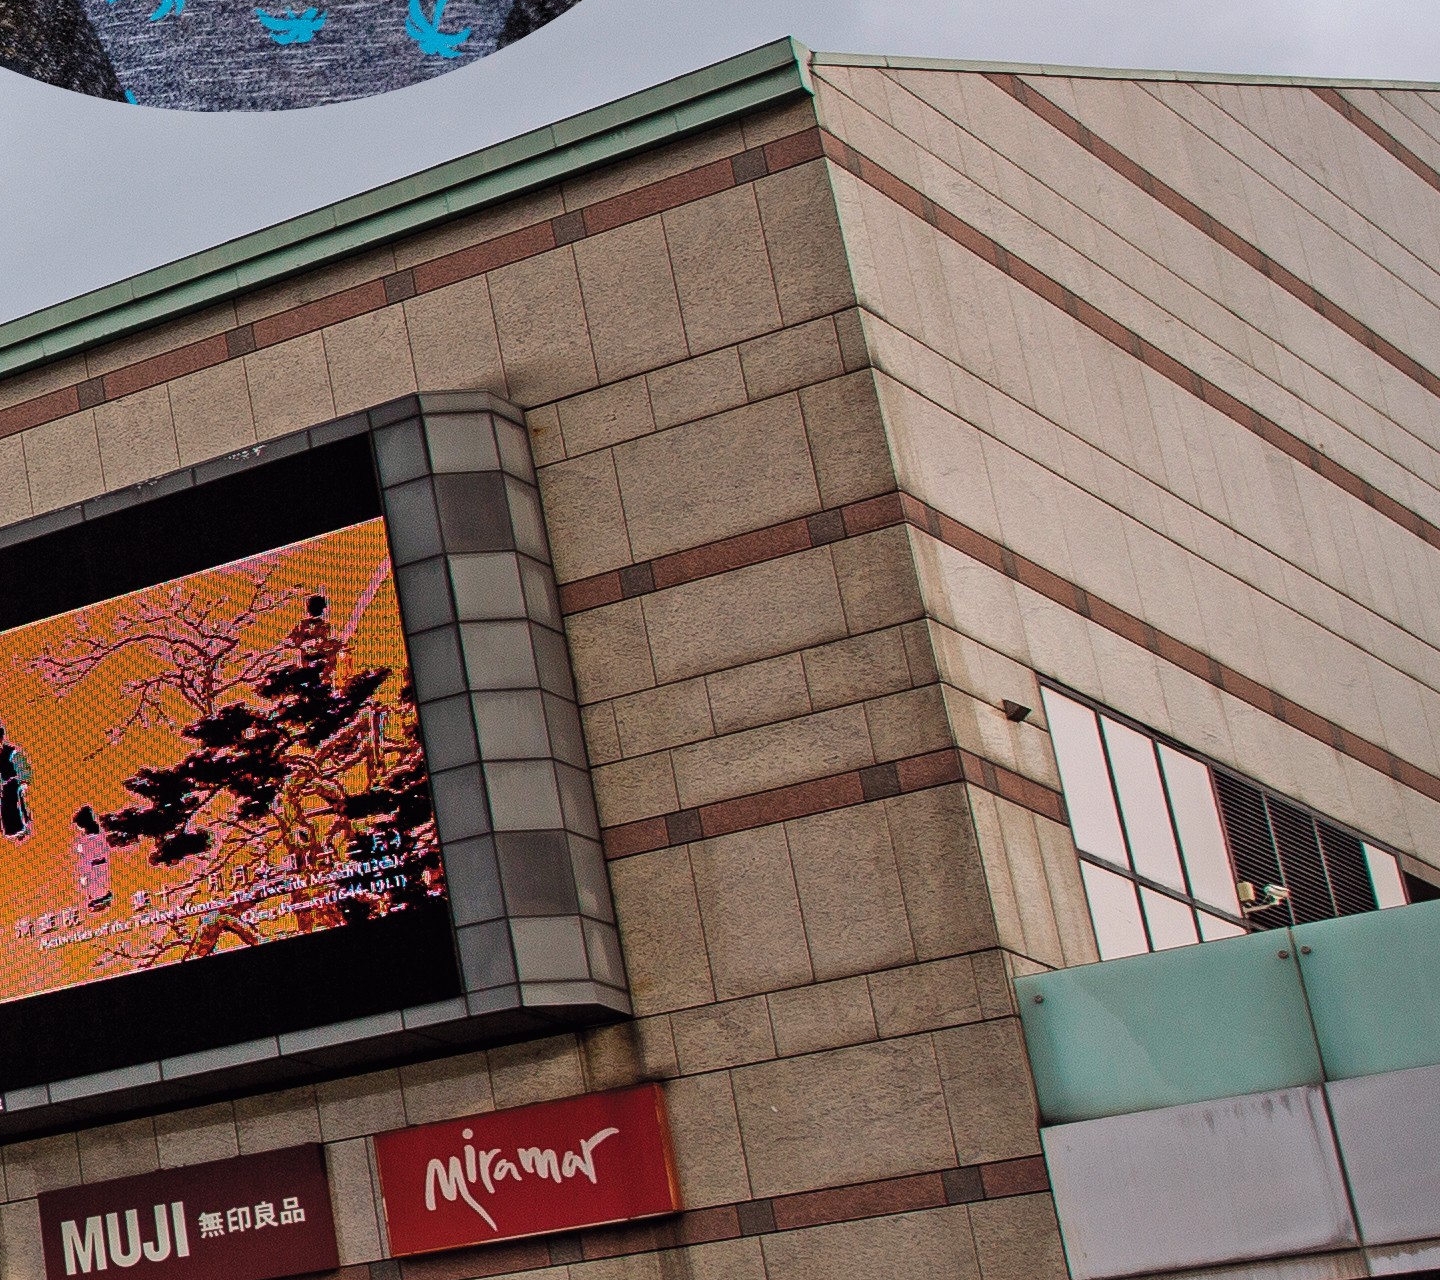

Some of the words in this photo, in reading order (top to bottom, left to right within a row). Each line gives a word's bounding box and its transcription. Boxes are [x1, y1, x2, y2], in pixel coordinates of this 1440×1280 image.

[62, 1201, 190, 1276] MUJI
[197, 1196, 307, 1240] 無印良品
